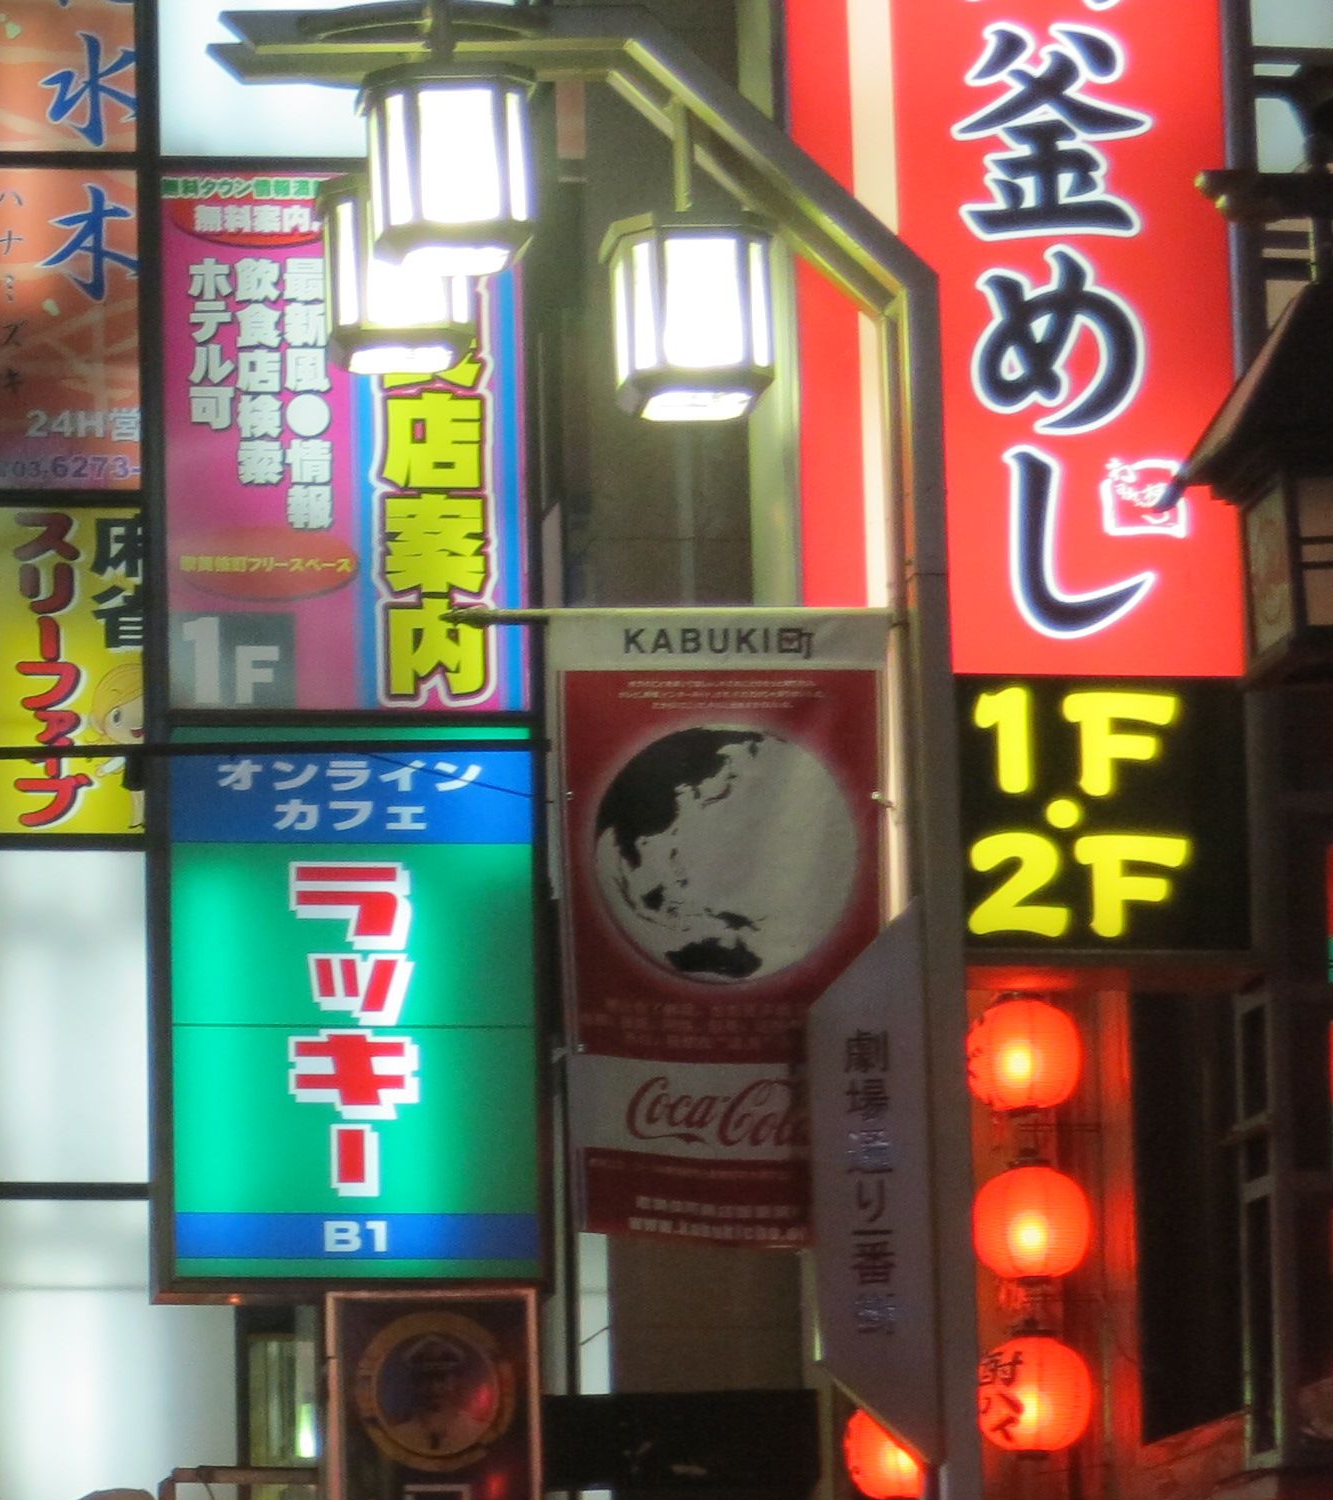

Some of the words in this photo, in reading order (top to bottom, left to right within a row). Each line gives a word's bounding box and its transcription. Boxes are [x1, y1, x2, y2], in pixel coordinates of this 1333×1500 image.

[194, 204, 323, 234] 無料案内
[188, 257, 235, 431] ホテル可
[235, 257, 284, 486] 飲食店検索
[953, 22, 1156, 640] 釜めし
[13, 511, 93, 828] スリーファイブ
[182, 617, 280, 705] 1F
[623, 627, 814, 660] KABUKI町
[217, 760, 484, 793] オンライン
[974, 687, 1181, 798] 1F
[273, 799, 428, 832] カフェ
[968, 831, 1190, 940] 2F
[289, 862, 421, 1198] ラッキー
[324, 1220, 389, 1254] B1
[844, 1028, 897, 1336] 劇場通り一番街
